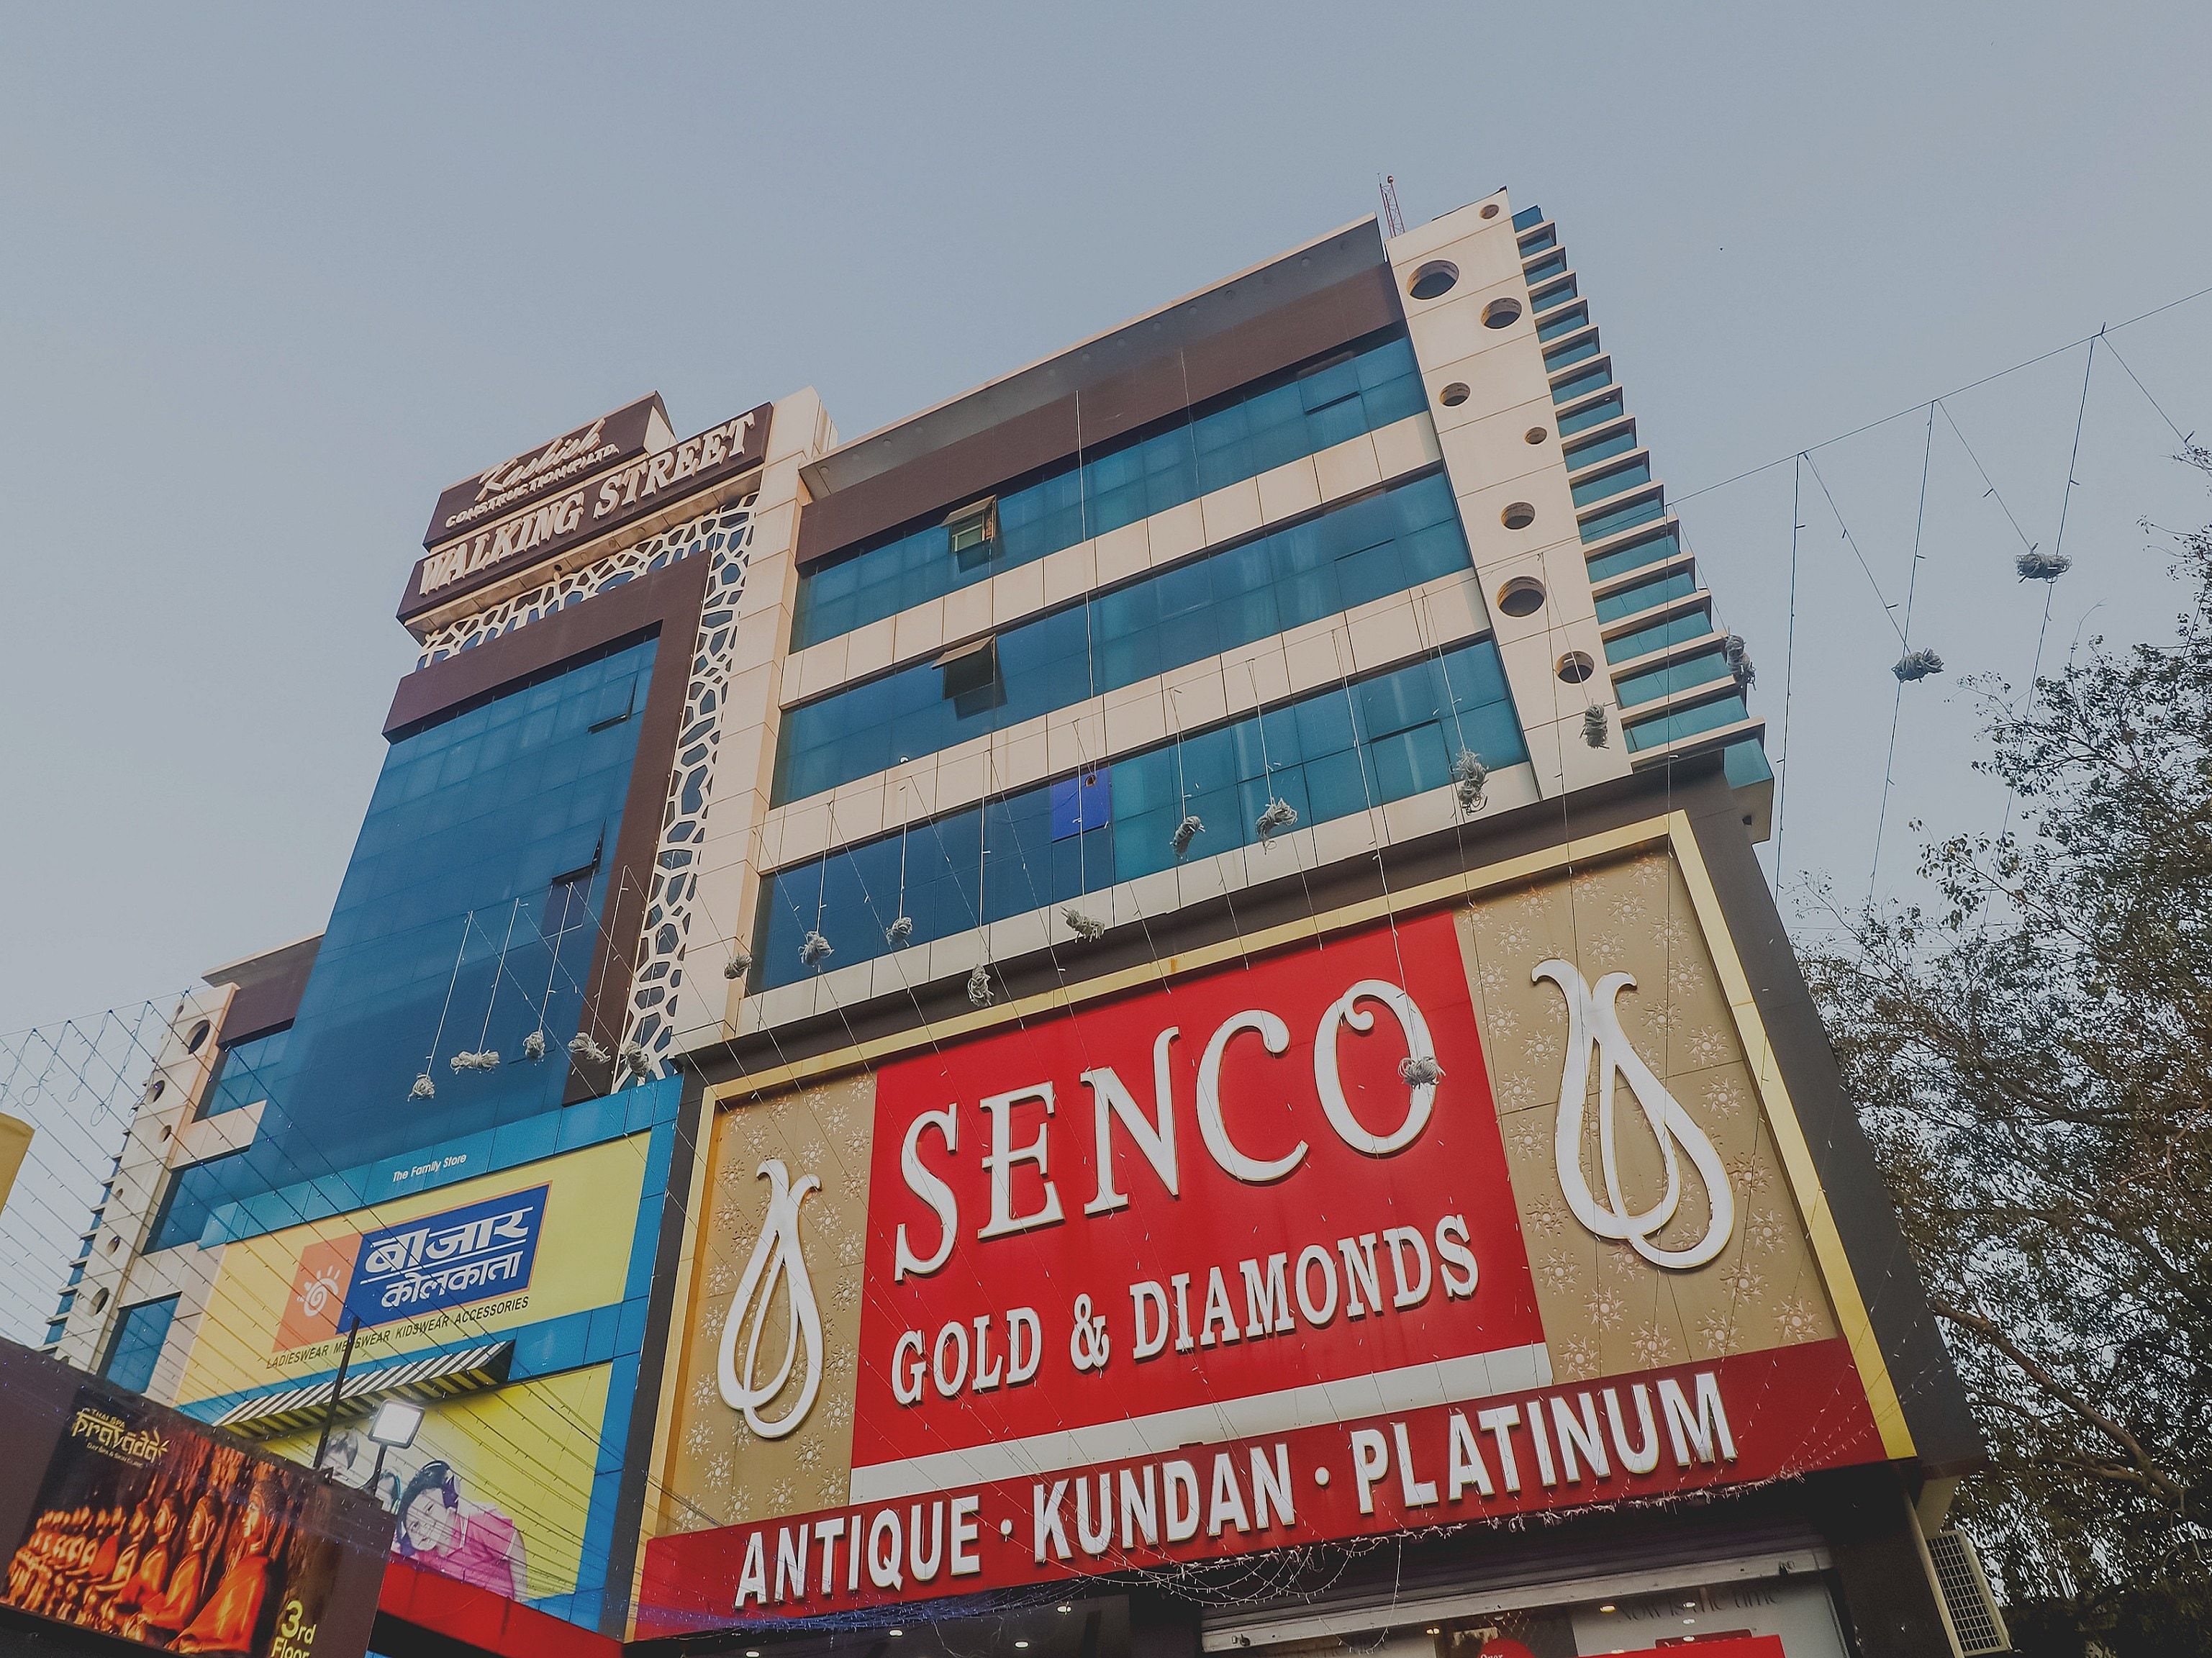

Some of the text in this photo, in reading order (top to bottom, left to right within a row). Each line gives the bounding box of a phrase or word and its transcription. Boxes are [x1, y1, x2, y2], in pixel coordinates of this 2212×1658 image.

[419, 412, 756, 596] WALKING STREET
[894, 978, 1439, 1282] SENCO
[393, 1154, 468, 1182] The Family Store
[365, 1205, 535, 1273] बाजार
[381, 1250, 524, 1308] कोलकाता
[892, 1214, 1479, 1406] GOLD & DIAMONDS
[266, 1296, 530, 1369] LADIESWEAR MESWEAR KIDSWEAR ACCESSORIES
[735, 1494, 981, 1609] ANTIQUE
[1033, 1442, 1295, 1563] KUNDAN
[1351, 1372, 1735, 1514] PLATINUM
[281, 1600, 317, 1645] 3rd
